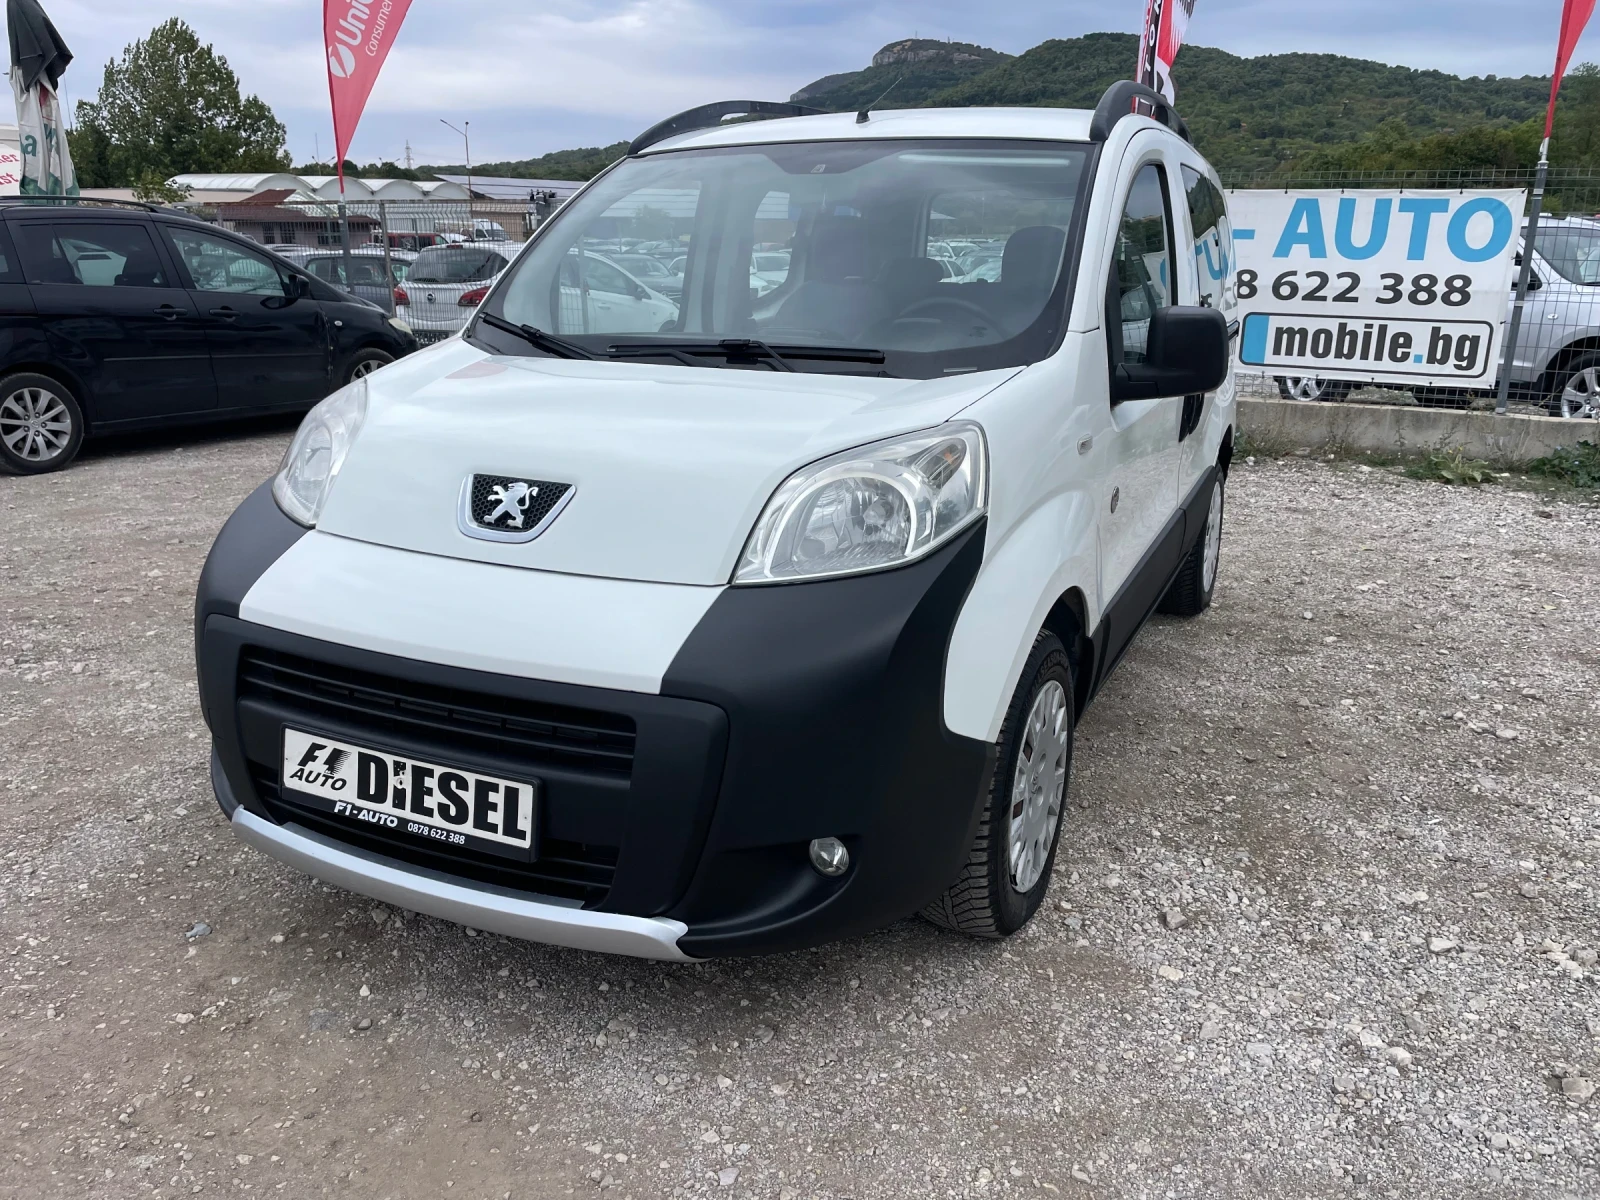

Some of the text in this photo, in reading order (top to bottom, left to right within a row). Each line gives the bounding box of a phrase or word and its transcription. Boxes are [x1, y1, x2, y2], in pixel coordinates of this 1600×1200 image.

[1272, 197, 1513, 262] AUTO
[1271, 270, 1361, 303] 622
[1375, 272, 1472, 307] 388
[1272, 322, 1481, 371] mobile.bg
[297, 742, 352, 775] F1
[290, 768, 347, 791] AUTO
[334, 800, 466, 845] F1-AUTO 0878 622 388
